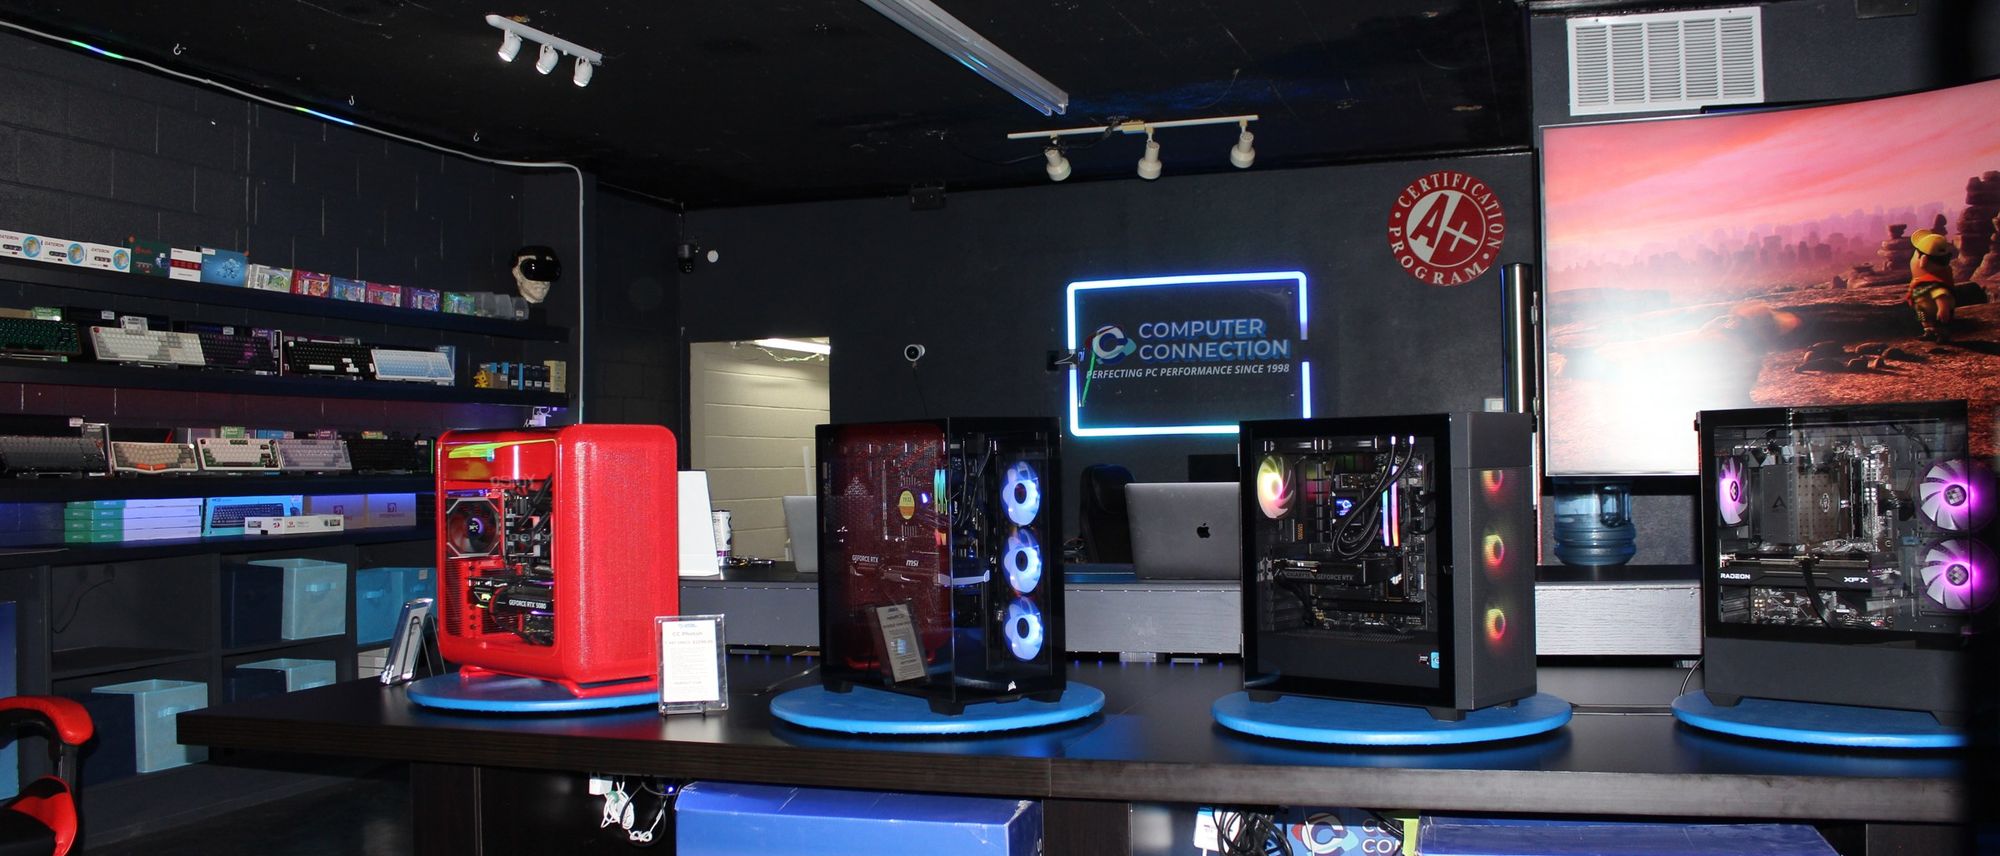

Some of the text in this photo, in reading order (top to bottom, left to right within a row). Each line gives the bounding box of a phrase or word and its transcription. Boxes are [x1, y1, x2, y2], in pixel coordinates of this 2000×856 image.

[1398, 172, 1504, 249] CERTIFICATION
[1389, 225, 1482, 285] PROGRAM
[1138, 318, 1264, 339] COMPUTER
[1139, 339, 1289, 360] CONNECTION
[1086, 363, 1290, 379] PERFECTING PC PERFORMANCE SINCE 1998
[1720, 572, 1751, 580] RADEON
[1843, 576, 1869, 584] XFX
[508, 599, 527, 607] GEFORCE
